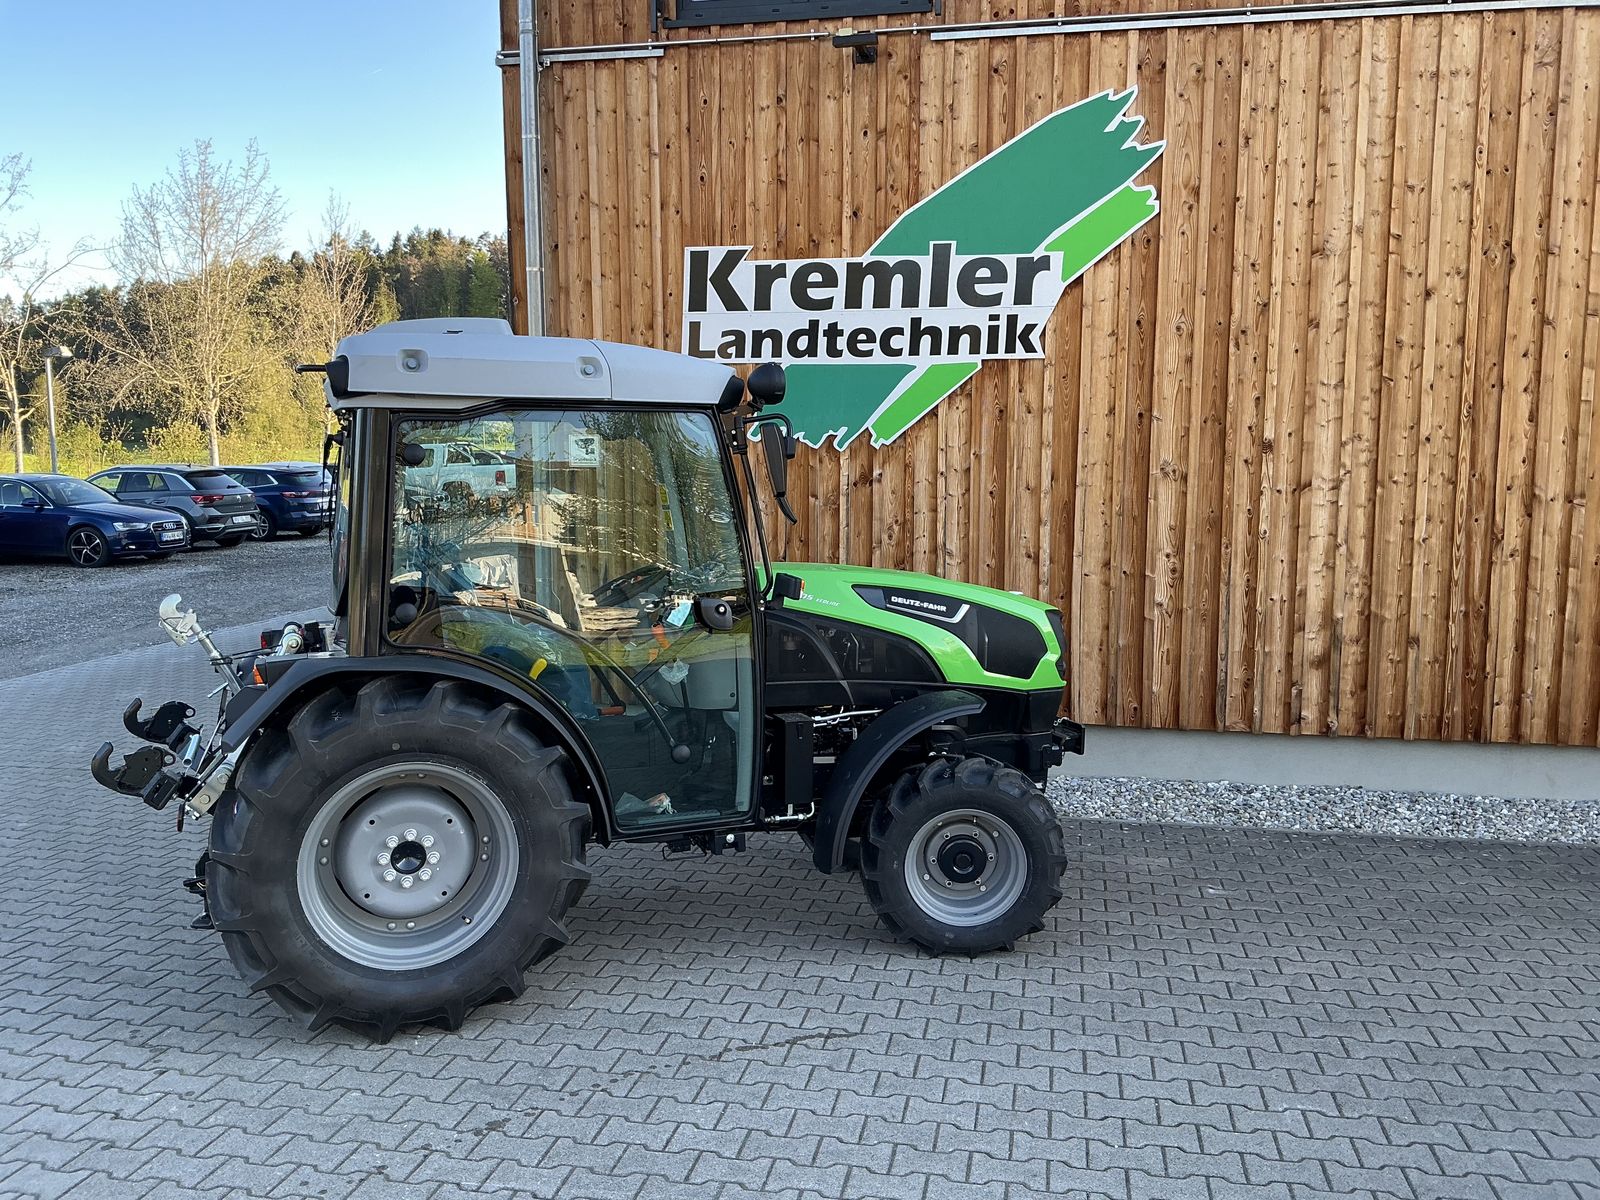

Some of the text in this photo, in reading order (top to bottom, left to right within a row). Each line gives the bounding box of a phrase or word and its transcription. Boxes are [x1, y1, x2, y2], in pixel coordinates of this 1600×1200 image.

[688, 243, 1051, 312] Kremler
[688, 314, 1039, 358] Landtechnik
[891, 596, 947, 612] DEUTZ-FAHR
